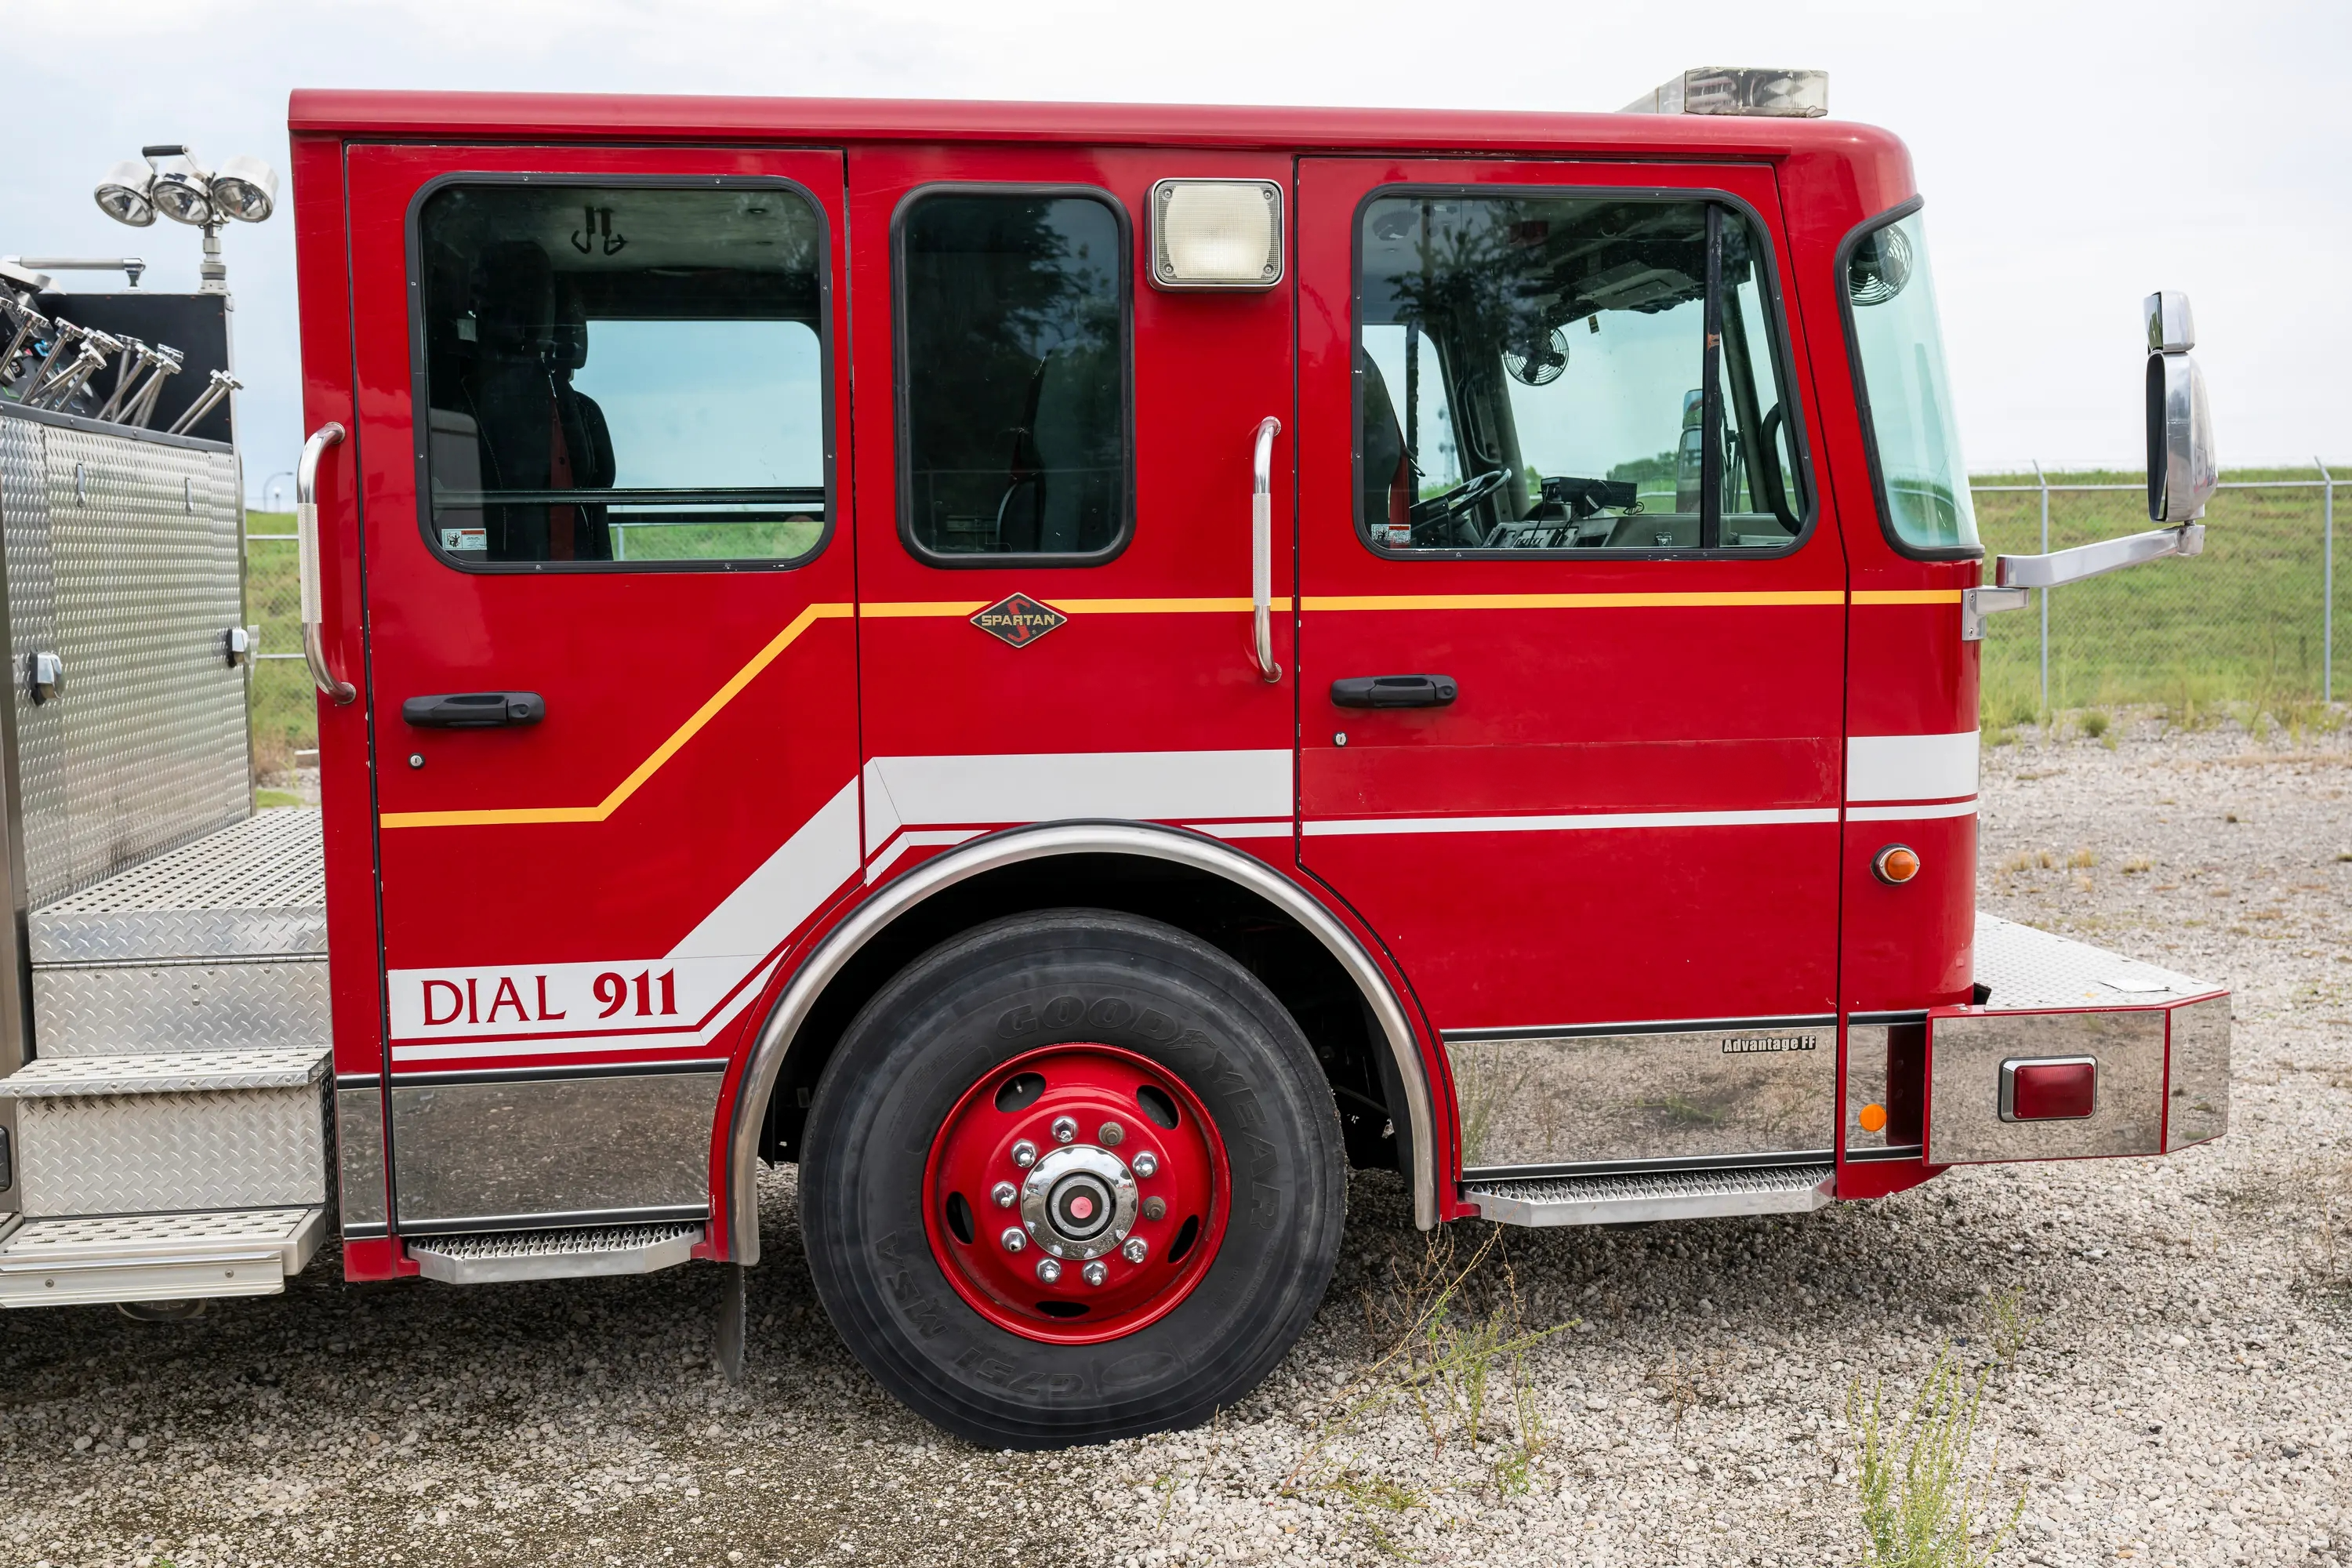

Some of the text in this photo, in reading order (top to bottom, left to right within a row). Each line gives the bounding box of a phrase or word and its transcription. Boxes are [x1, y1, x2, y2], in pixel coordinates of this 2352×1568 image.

[982, 615, 1054, 626] SPARTAN
[421, 966, 679, 1026] DIAL 911
[1723, 1035, 1816, 1052] Advantage FF
[996, 995, 1283, 1231] GOODYEAR
[873, 1229, 1085, 1398] G751 MSA
